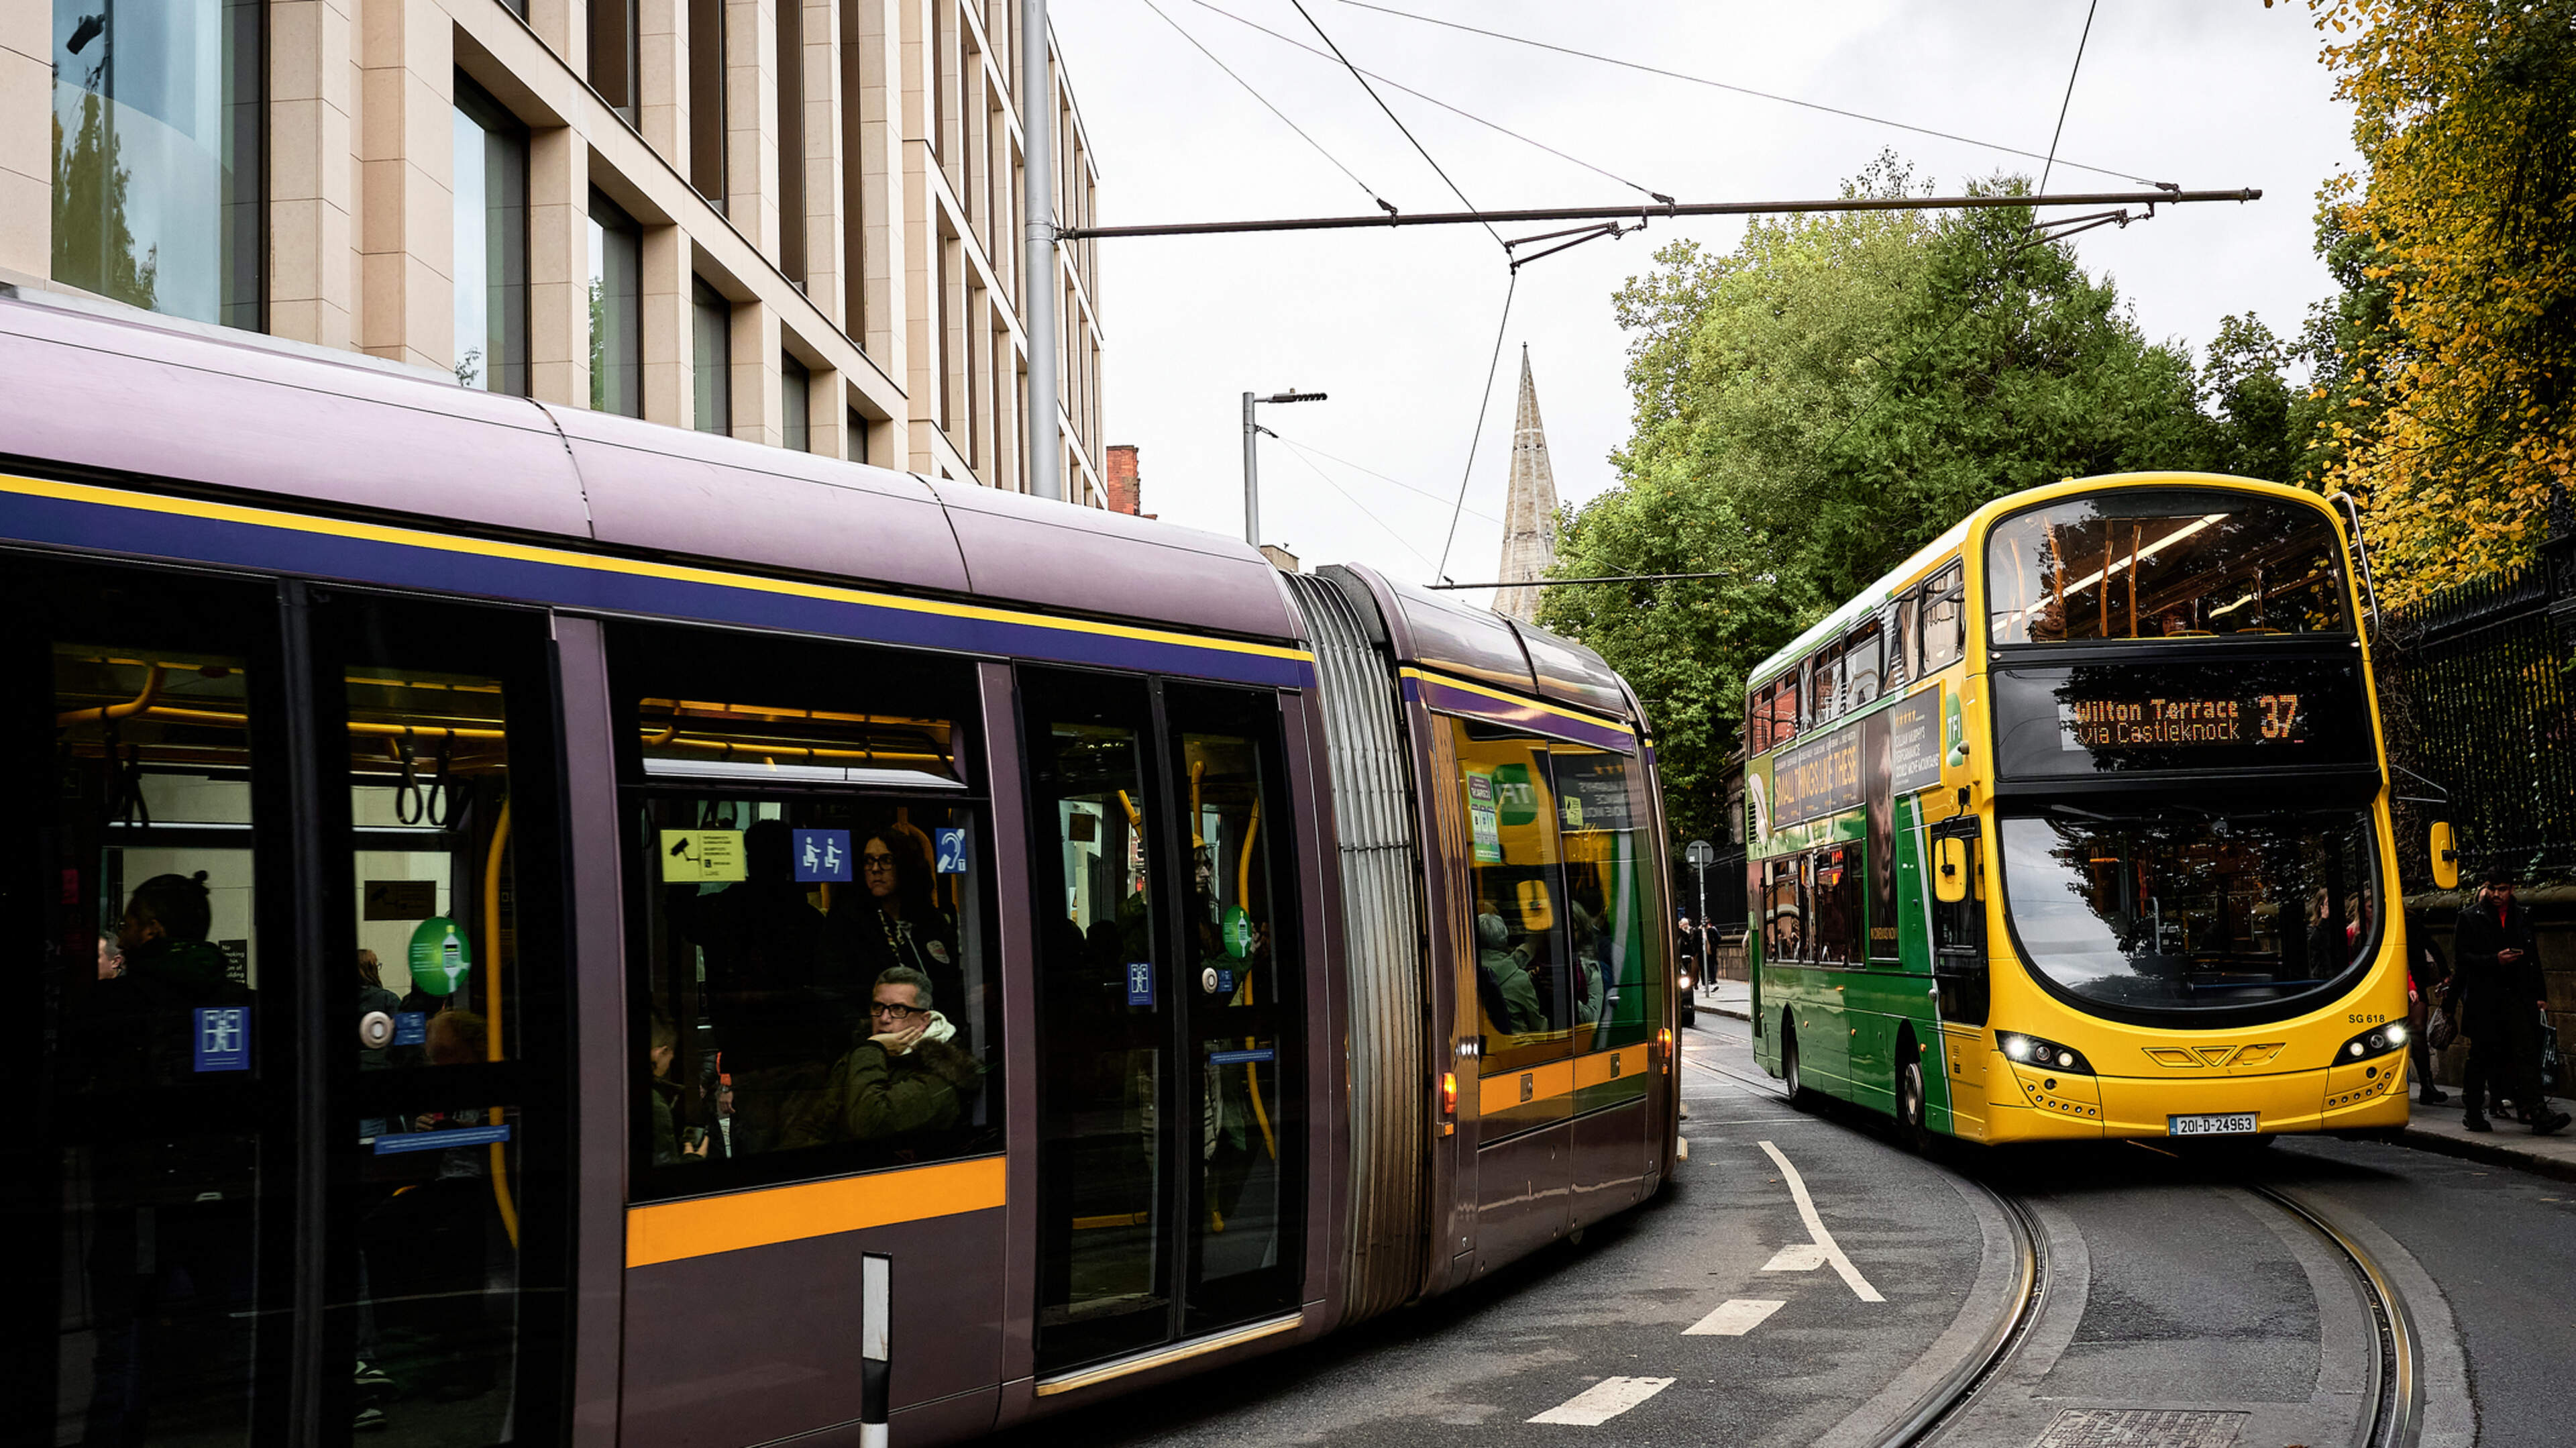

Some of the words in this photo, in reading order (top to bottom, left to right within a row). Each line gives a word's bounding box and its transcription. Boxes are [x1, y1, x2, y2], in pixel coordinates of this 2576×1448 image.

[2076, 701, 2142, 722] Wilton
[2151, 699, 2239, 719] Terrace
[2259, 694, 2298, 738] 37
[1947, 713, 1961, 742] TFI
[2117, 719, 2241, 743] Castleknock
[1834, 745, 1857, 788] THESE
[2349, 1014, 2364, 1023] SG
[2367, 1014, 2385, 1023] 618
[2180, 1117, 2252, 1133] 201-D-24963
